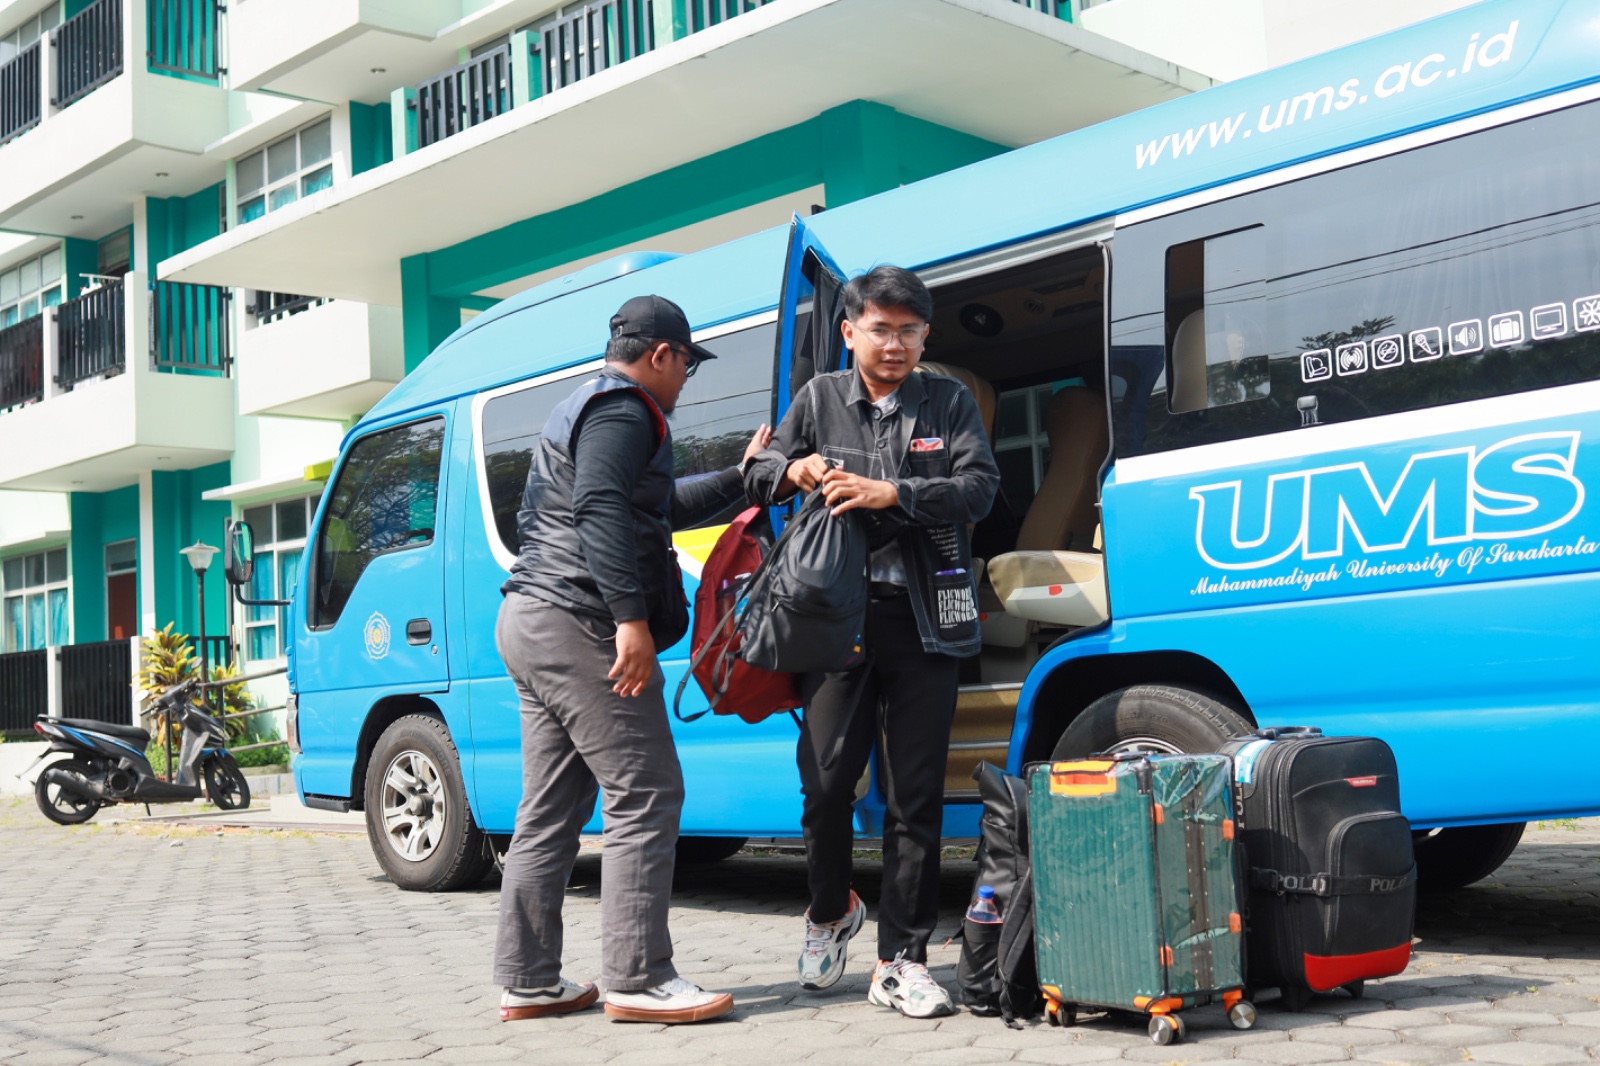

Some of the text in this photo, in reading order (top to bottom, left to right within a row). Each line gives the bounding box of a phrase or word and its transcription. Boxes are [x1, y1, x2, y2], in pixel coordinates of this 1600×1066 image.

[1135, 19, 1520, 171] www.ums.ac.id
[1189, 431, 1586, 569] UMS
[1190, 535, 1600, 595] Muhammadiyah University Of Surakarta
[1369, 877, 1408, 892] POLO
